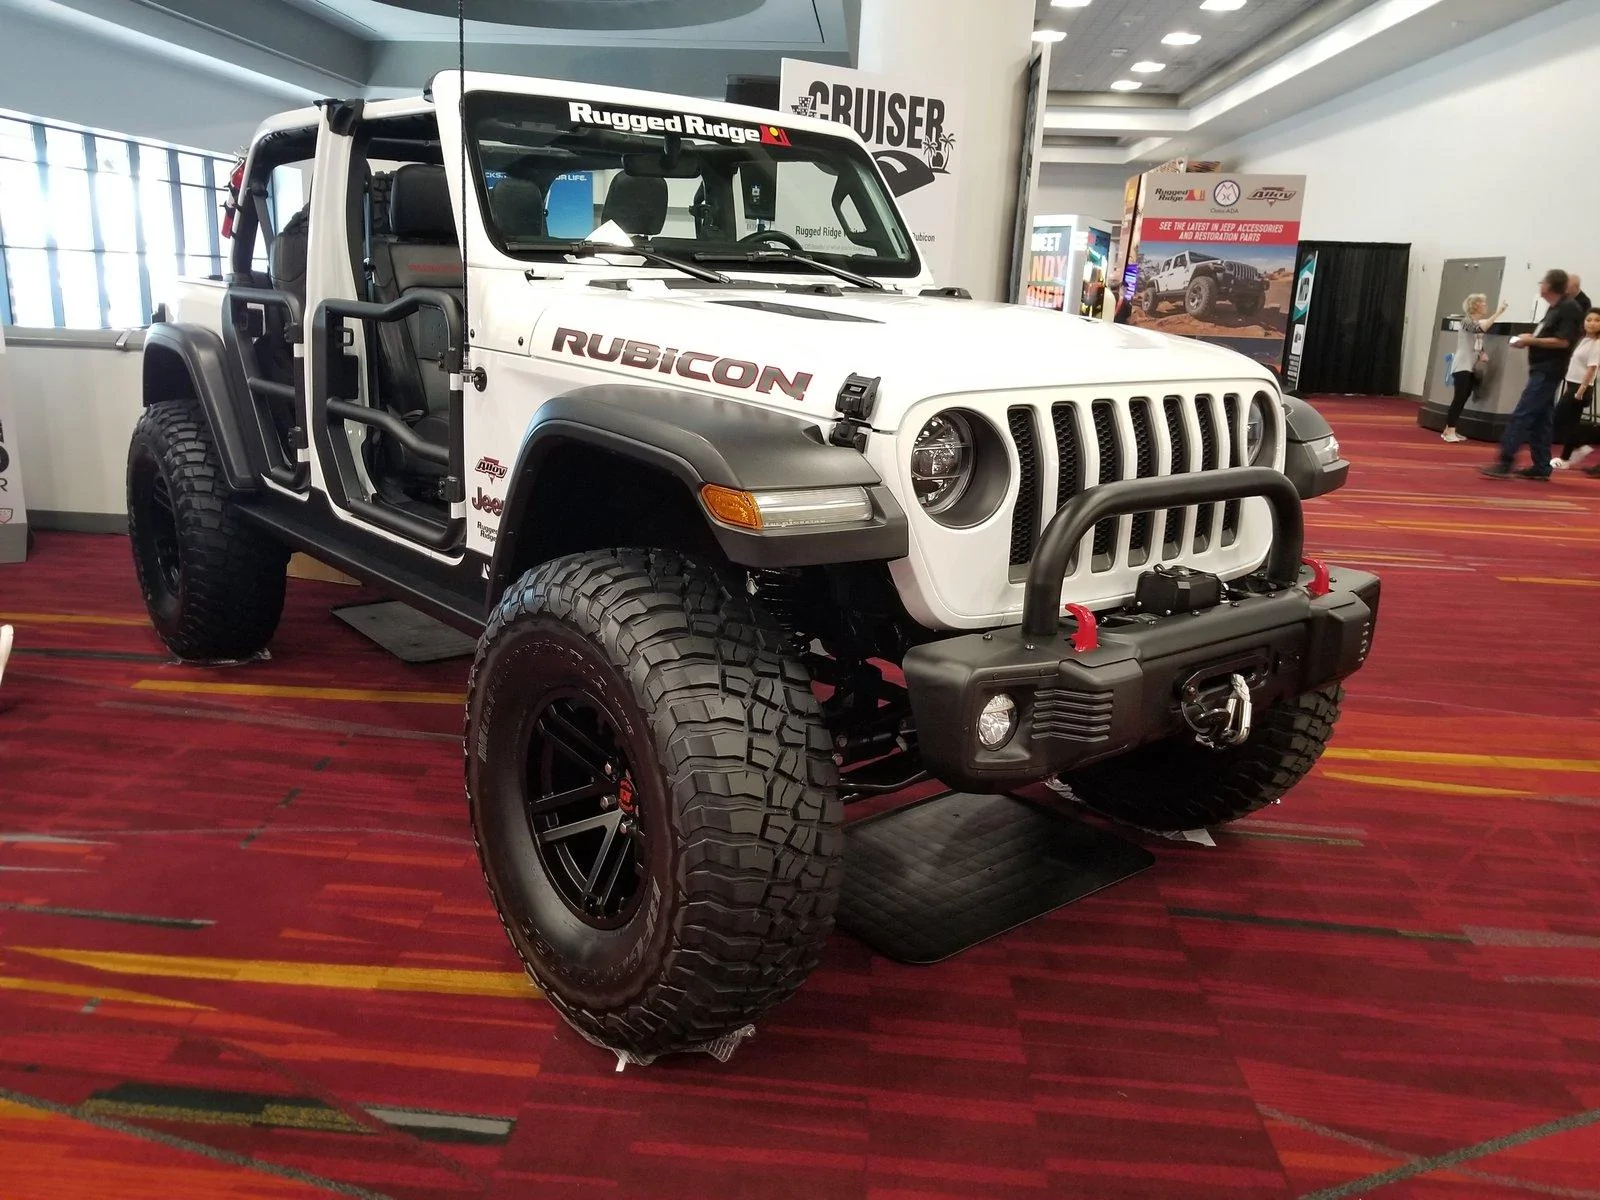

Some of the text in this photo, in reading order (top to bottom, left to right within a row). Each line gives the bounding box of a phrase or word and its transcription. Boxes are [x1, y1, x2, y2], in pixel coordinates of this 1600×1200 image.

[568, 101, 760, 143] Rugged Ridge
[808, 81, 945, 151] CRUISER
[1155, 188, 1188, 197] Rugged
[795, 226, 822, 238] Rugged
[823, 226, 843, 239] Ridge
[1159, 222, 1171, 230] SEE
[1173, 222, 1185, 230] THE
[1187, 223, 1210, 231] LATEST
[1219, 224, 1236, 232] JEEP
[1237, 225, 1284, 233] ACCESSORIES
[1179, 232, 1261, 241] AND RESTORATION PARTS
[552, 327, 813, 401] RUBICON
[476, 460, 506, 477] Alloy
